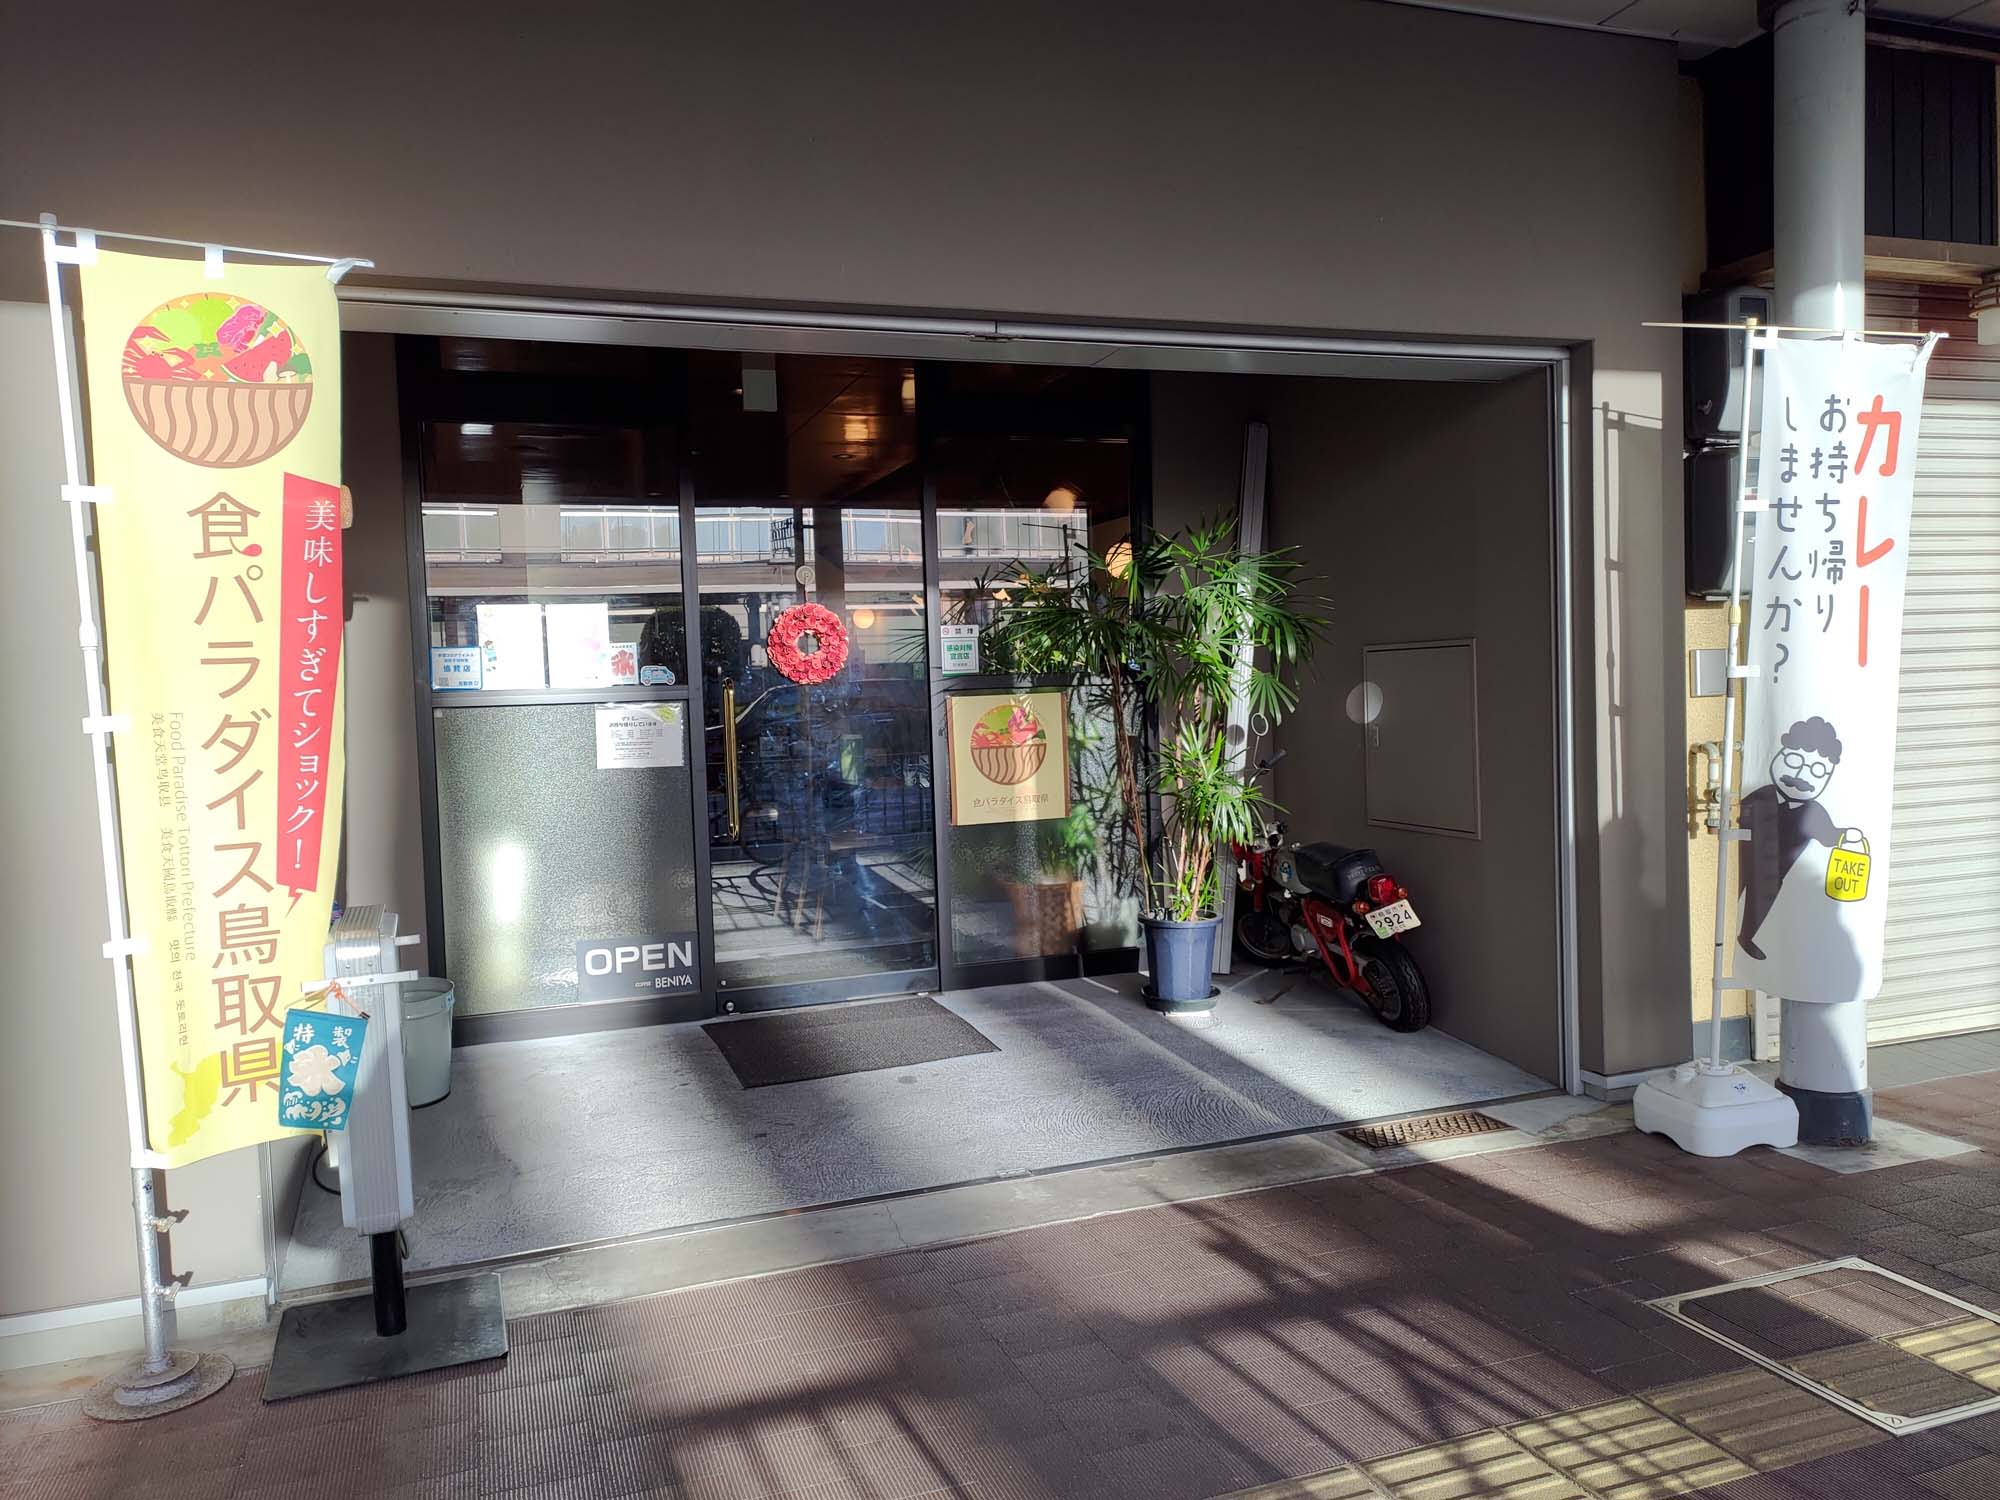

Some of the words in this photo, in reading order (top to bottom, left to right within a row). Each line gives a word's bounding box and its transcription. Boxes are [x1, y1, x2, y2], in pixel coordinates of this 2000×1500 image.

[1763, 396, 1803, 683] しませんか？
[1808, 393, 1849, 633] お持ち帰り
[1853, 394, 1902, 667] カレー
[286, 498, 336, 870] 美味しすぎてショック！
[169, 712, 185, 751] Food
[172, 755, 188, 822] Paradise
[187, 491, 282, 1107] 食パラダイス鳥取県
[1832, 857, 1865, 877] TAKE
[1834, 875, 1860, 894] OUT
[182, 881, 197, 961] Prefecture
[585, 940, 693, 976] OPEN
[655, 974, 692, 988] BENIYA
